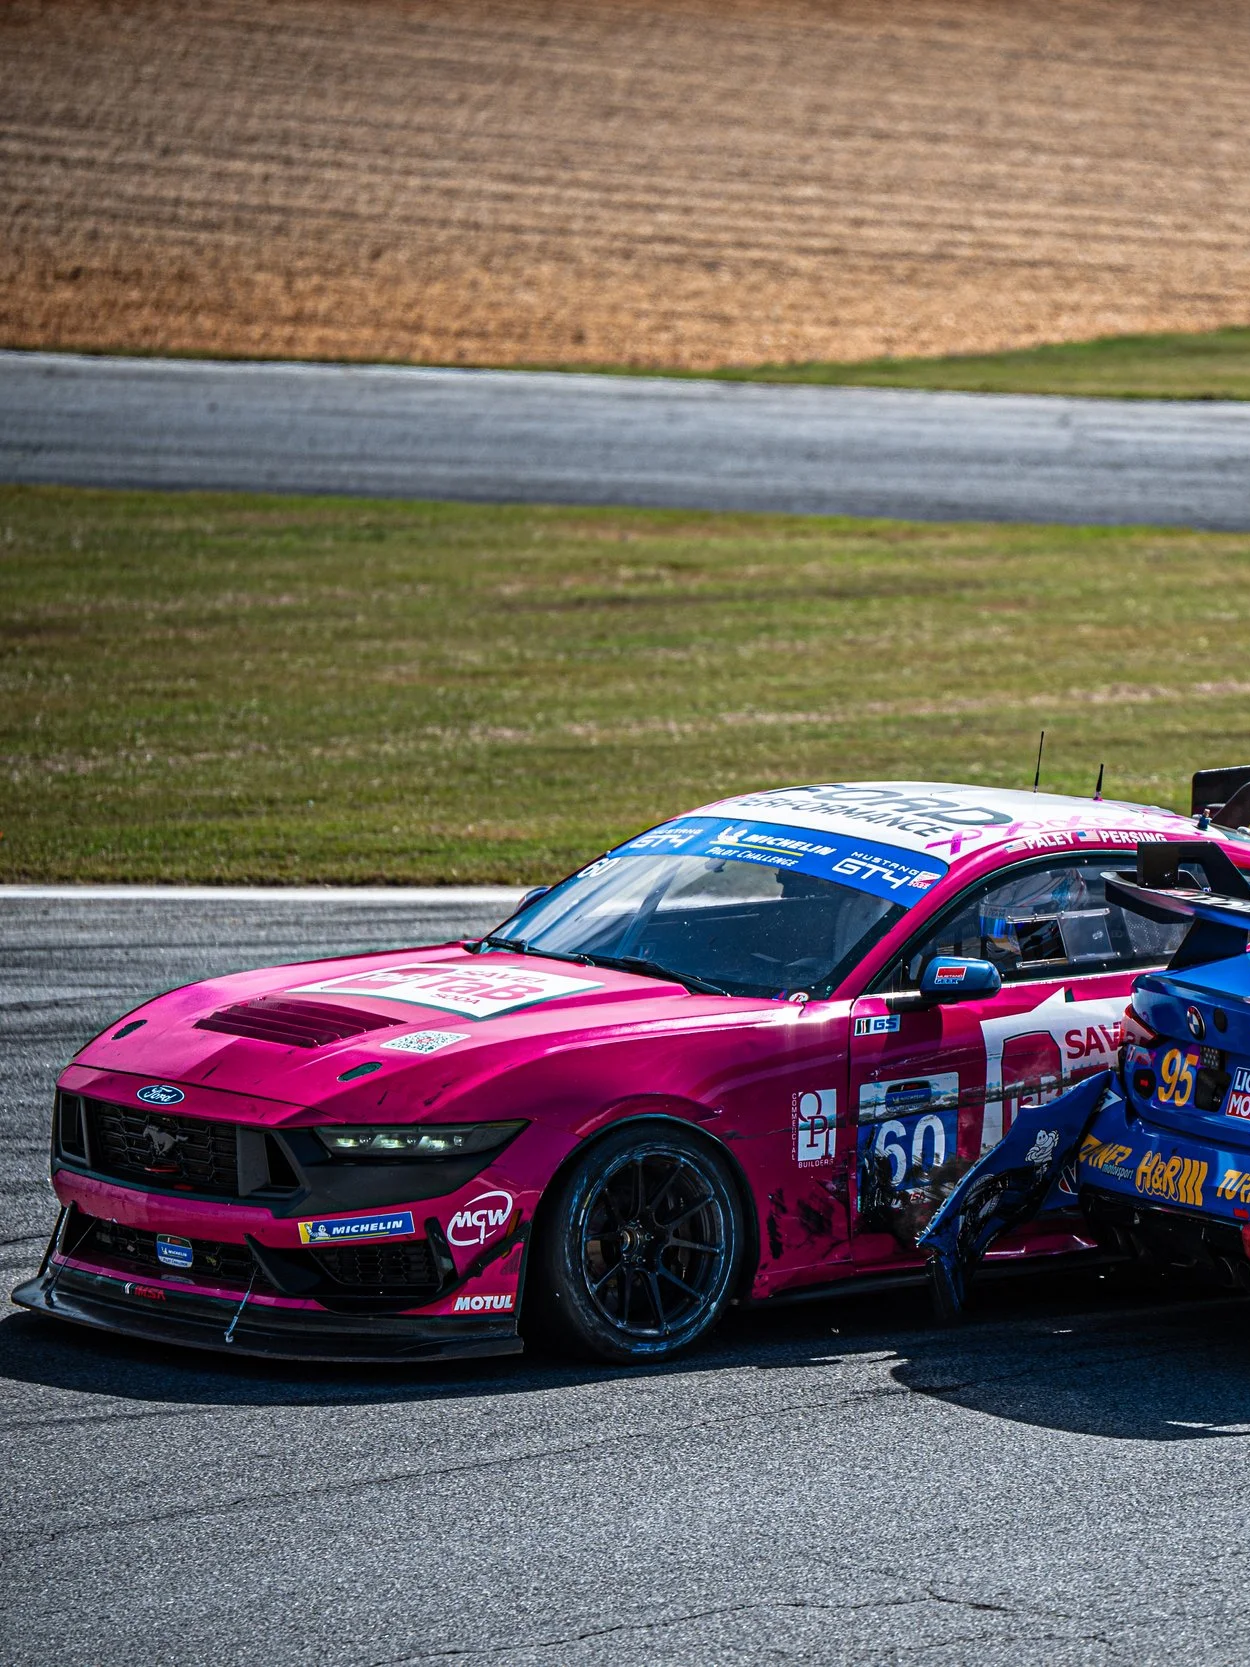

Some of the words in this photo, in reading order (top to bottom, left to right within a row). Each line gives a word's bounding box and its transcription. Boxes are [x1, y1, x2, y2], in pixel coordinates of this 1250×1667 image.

[734, 798, 955, 838] PERFORMANCE
[629, 835, 695, 848] GT4
[745, 833, 838, 856] MICHELIN
[1026, 831, 1076, 850] PALEY
[1100, 830, 1168, 844] PERSING
[705, 846, 734, 857] PILOT
[738, 850, 799, 867] CHALLENGE
[851, 852, 920, 876] MUSTANG
[577, 857, 621, 878] 60
[832, 857, 911, 890] GT4
[416, 976, 545, 1001] TaB
[434, 993, 481, 1005] SODA
[873, 1016, 897, 1031] GS
[1158, 1048, 1199, 1107] 95
[144, 1085, 178, 1102] Ford
[874, 1113, 946, 1188] 60
[332, 1219, 403, 1236] MICHELIN
[134, 1285, 166, 1301] IMSA
[454, 1295, 513, 1311] MOTUL
